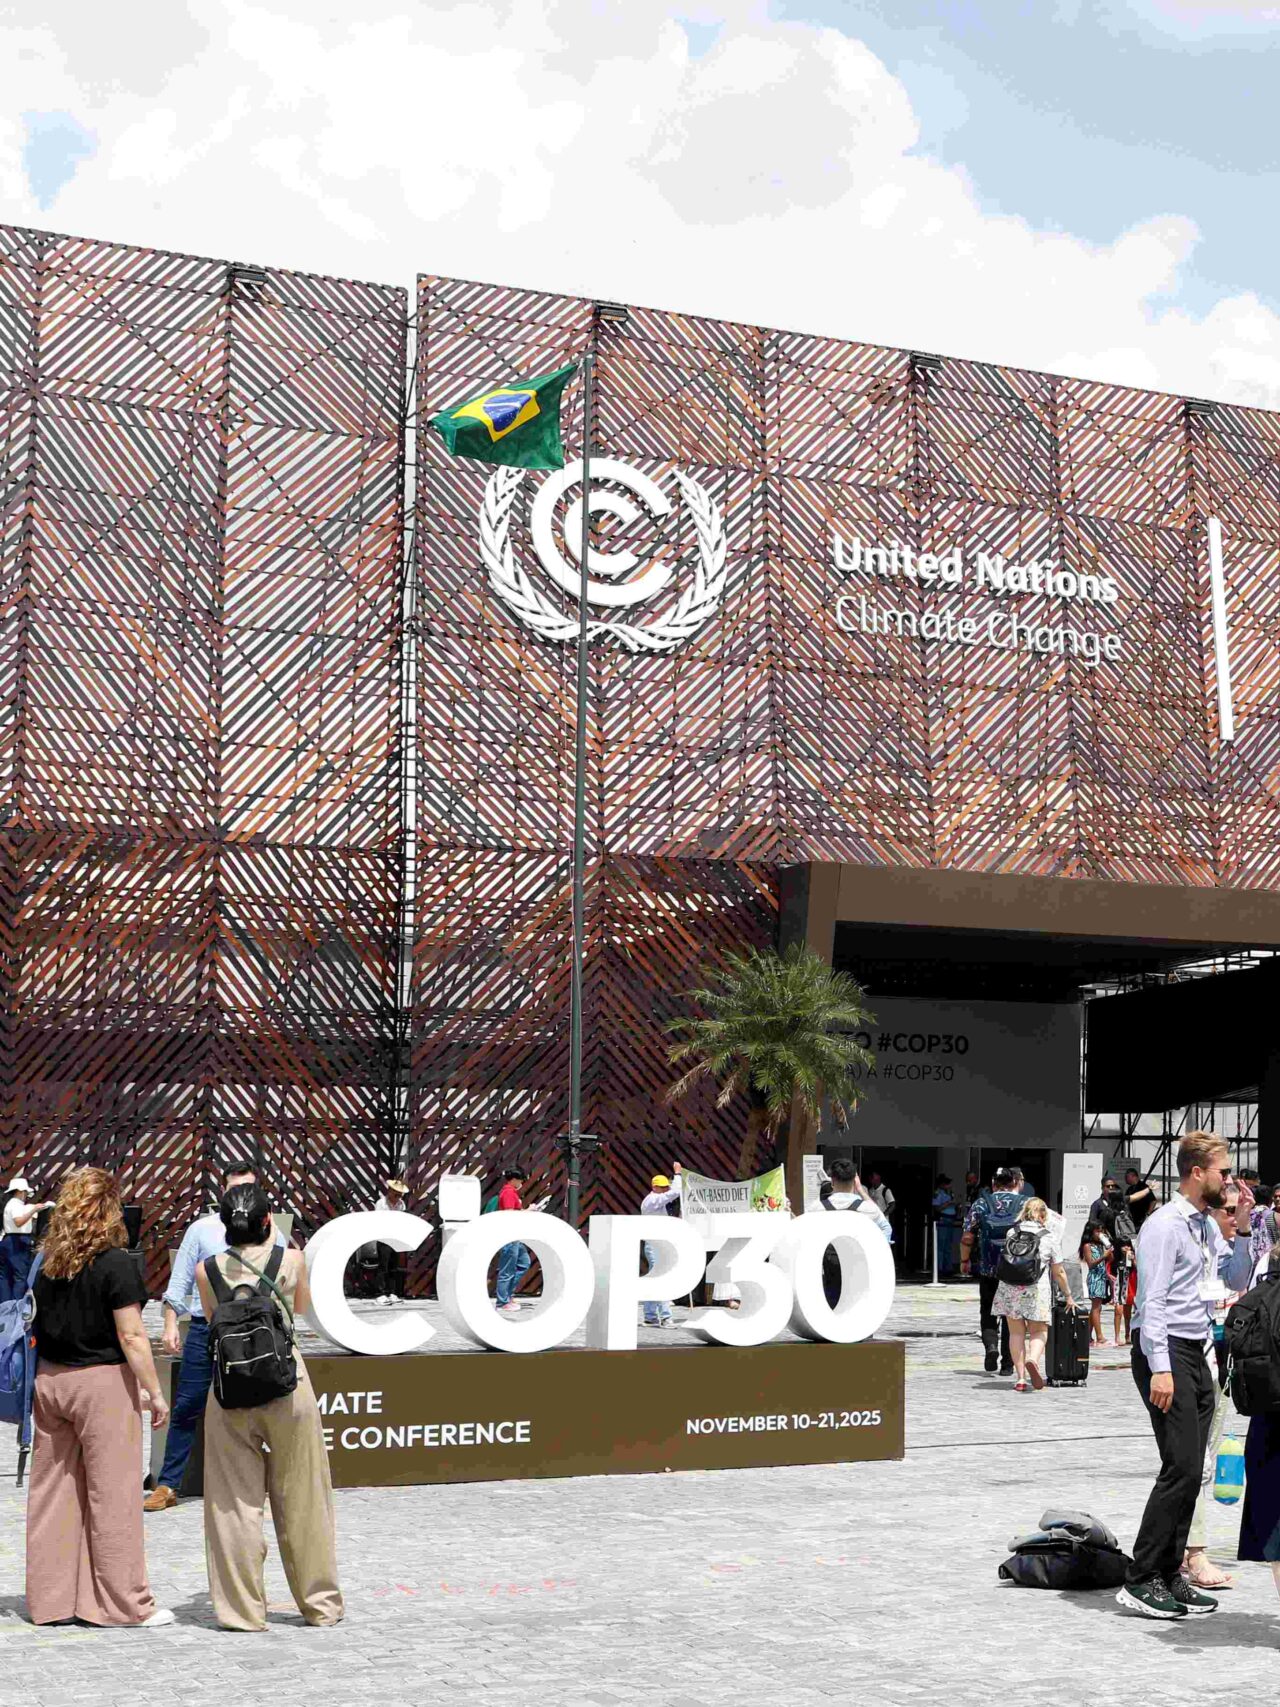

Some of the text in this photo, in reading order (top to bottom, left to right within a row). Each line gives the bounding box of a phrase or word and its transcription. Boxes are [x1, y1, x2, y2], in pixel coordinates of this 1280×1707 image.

[832, 532, 1119, 603] United Nations
[834, 594, 1122, 667] Climate Change
[877, 1032, 970, 1055] #COP30
[883, 1064, 955, 1082] #COP30
[732, 1187, 748, 1201] DIET
[304, 1209, 897, 1356] COP30
[340, 1420, 532, 1450] CONFERENCE
[686, 1409, 882, 1434] NOVEMBER 10-21,2025
